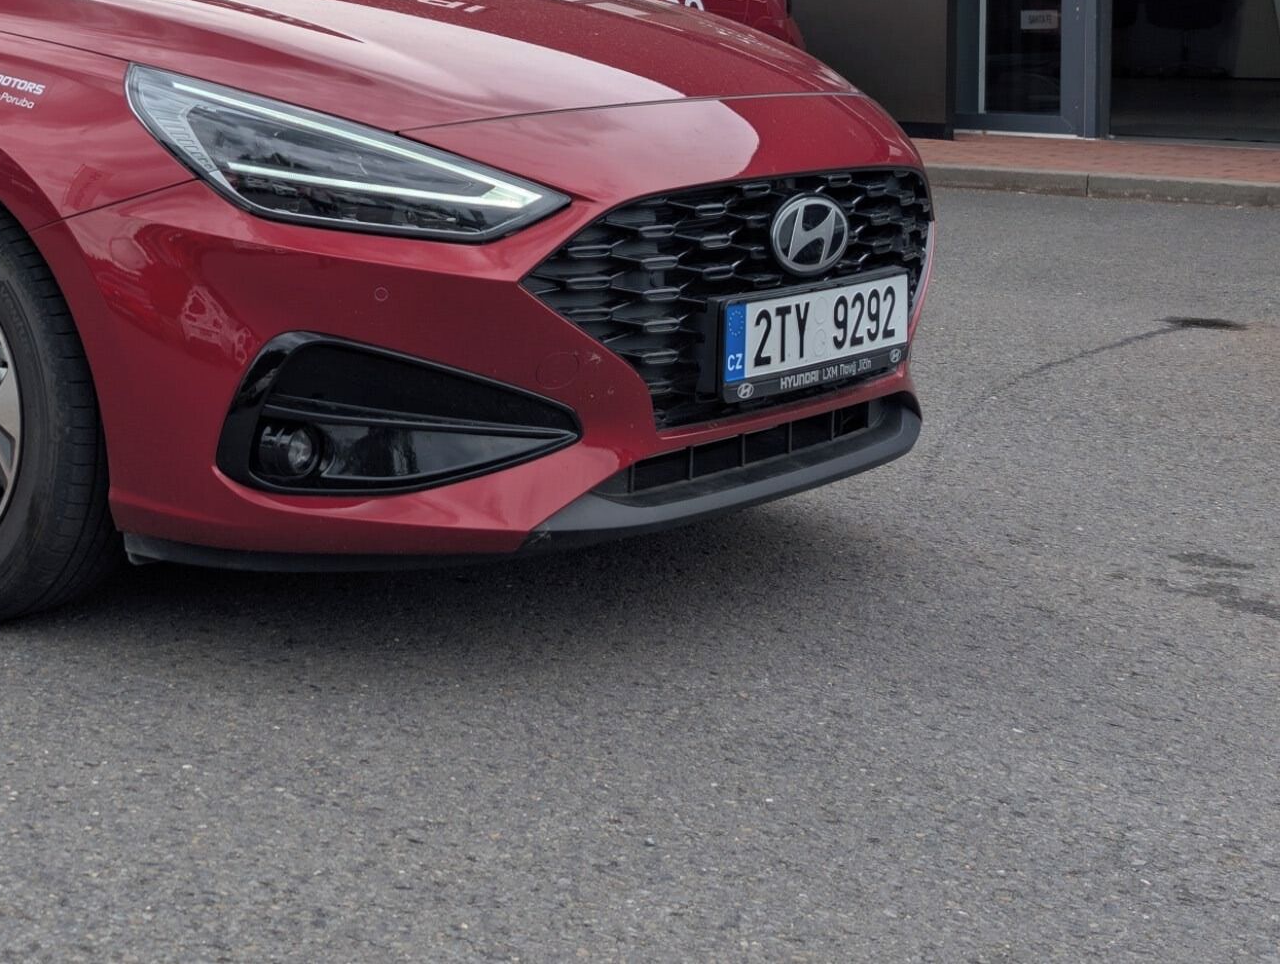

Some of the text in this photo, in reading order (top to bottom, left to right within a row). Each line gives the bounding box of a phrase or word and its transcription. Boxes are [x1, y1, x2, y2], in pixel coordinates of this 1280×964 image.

[752, 285, 896, 367] 2TY 9292
[727, 352, 743, 371] CZ
[780, 369, 819, 390] HYUNDAI
[822, 365, 838, 380] LXM
